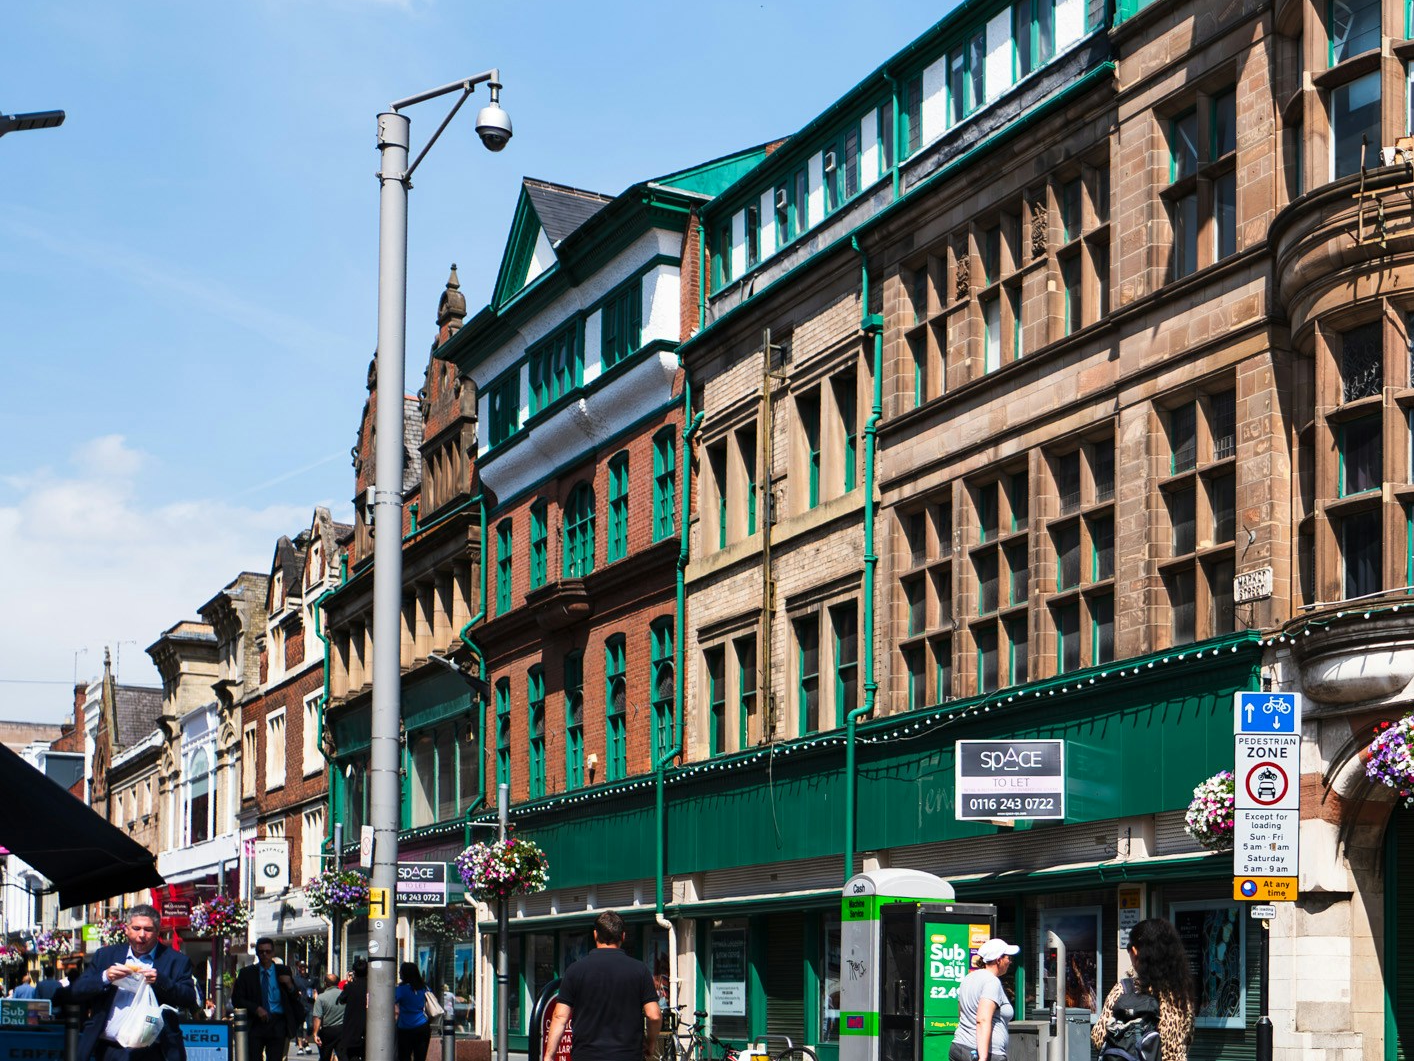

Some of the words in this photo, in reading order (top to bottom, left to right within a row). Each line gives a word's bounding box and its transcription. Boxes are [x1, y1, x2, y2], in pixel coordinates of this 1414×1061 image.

[1237, 570, 1266, 585] MARKET
[1239, 583, 1265, 599] STREET
[1238, 737, 1297, 746] PEDESTRIAN
[1247, 746, 1288, 759] ZONE
[992, 777, 1007, 788] TO
[1010, 777, 1030, 788] LET
[969, 798, 997, 810] 0116
[1000, 798, 1021, 810] 243
[1024, 797, 1054, 810] 0722
[1245, 813, 1274, 822] Except
[1275, 813, 1288, 821] for
[1251, 822, 1282, 830] loading
[1249, 833, 1266, 841] Sun
[1272, 833, 1284, 841] Fri
[1243, 843, 1249, 851] 5
[1247, 854, 1285, 865] Saturday
[1243, 865, 1249, 873] 5
[1269, 865, 1275, 873] 9
[852, 883, 866, 894] Cash
[1263, 880, 1273, 888] At
[1275, 881, 1290, 889] any
[409, 893, 421, 901] 243
[423, 893, 440, 902] 0722
[1267, 889, 1286, 897] time
[848, 900, 865, 909] Machine
[849, 910, 864, 918] Service
[930, 943, 966, 961] Sub
[930, 961, 966, 982] Day
[2, 1007, 25, 1016] Sub
